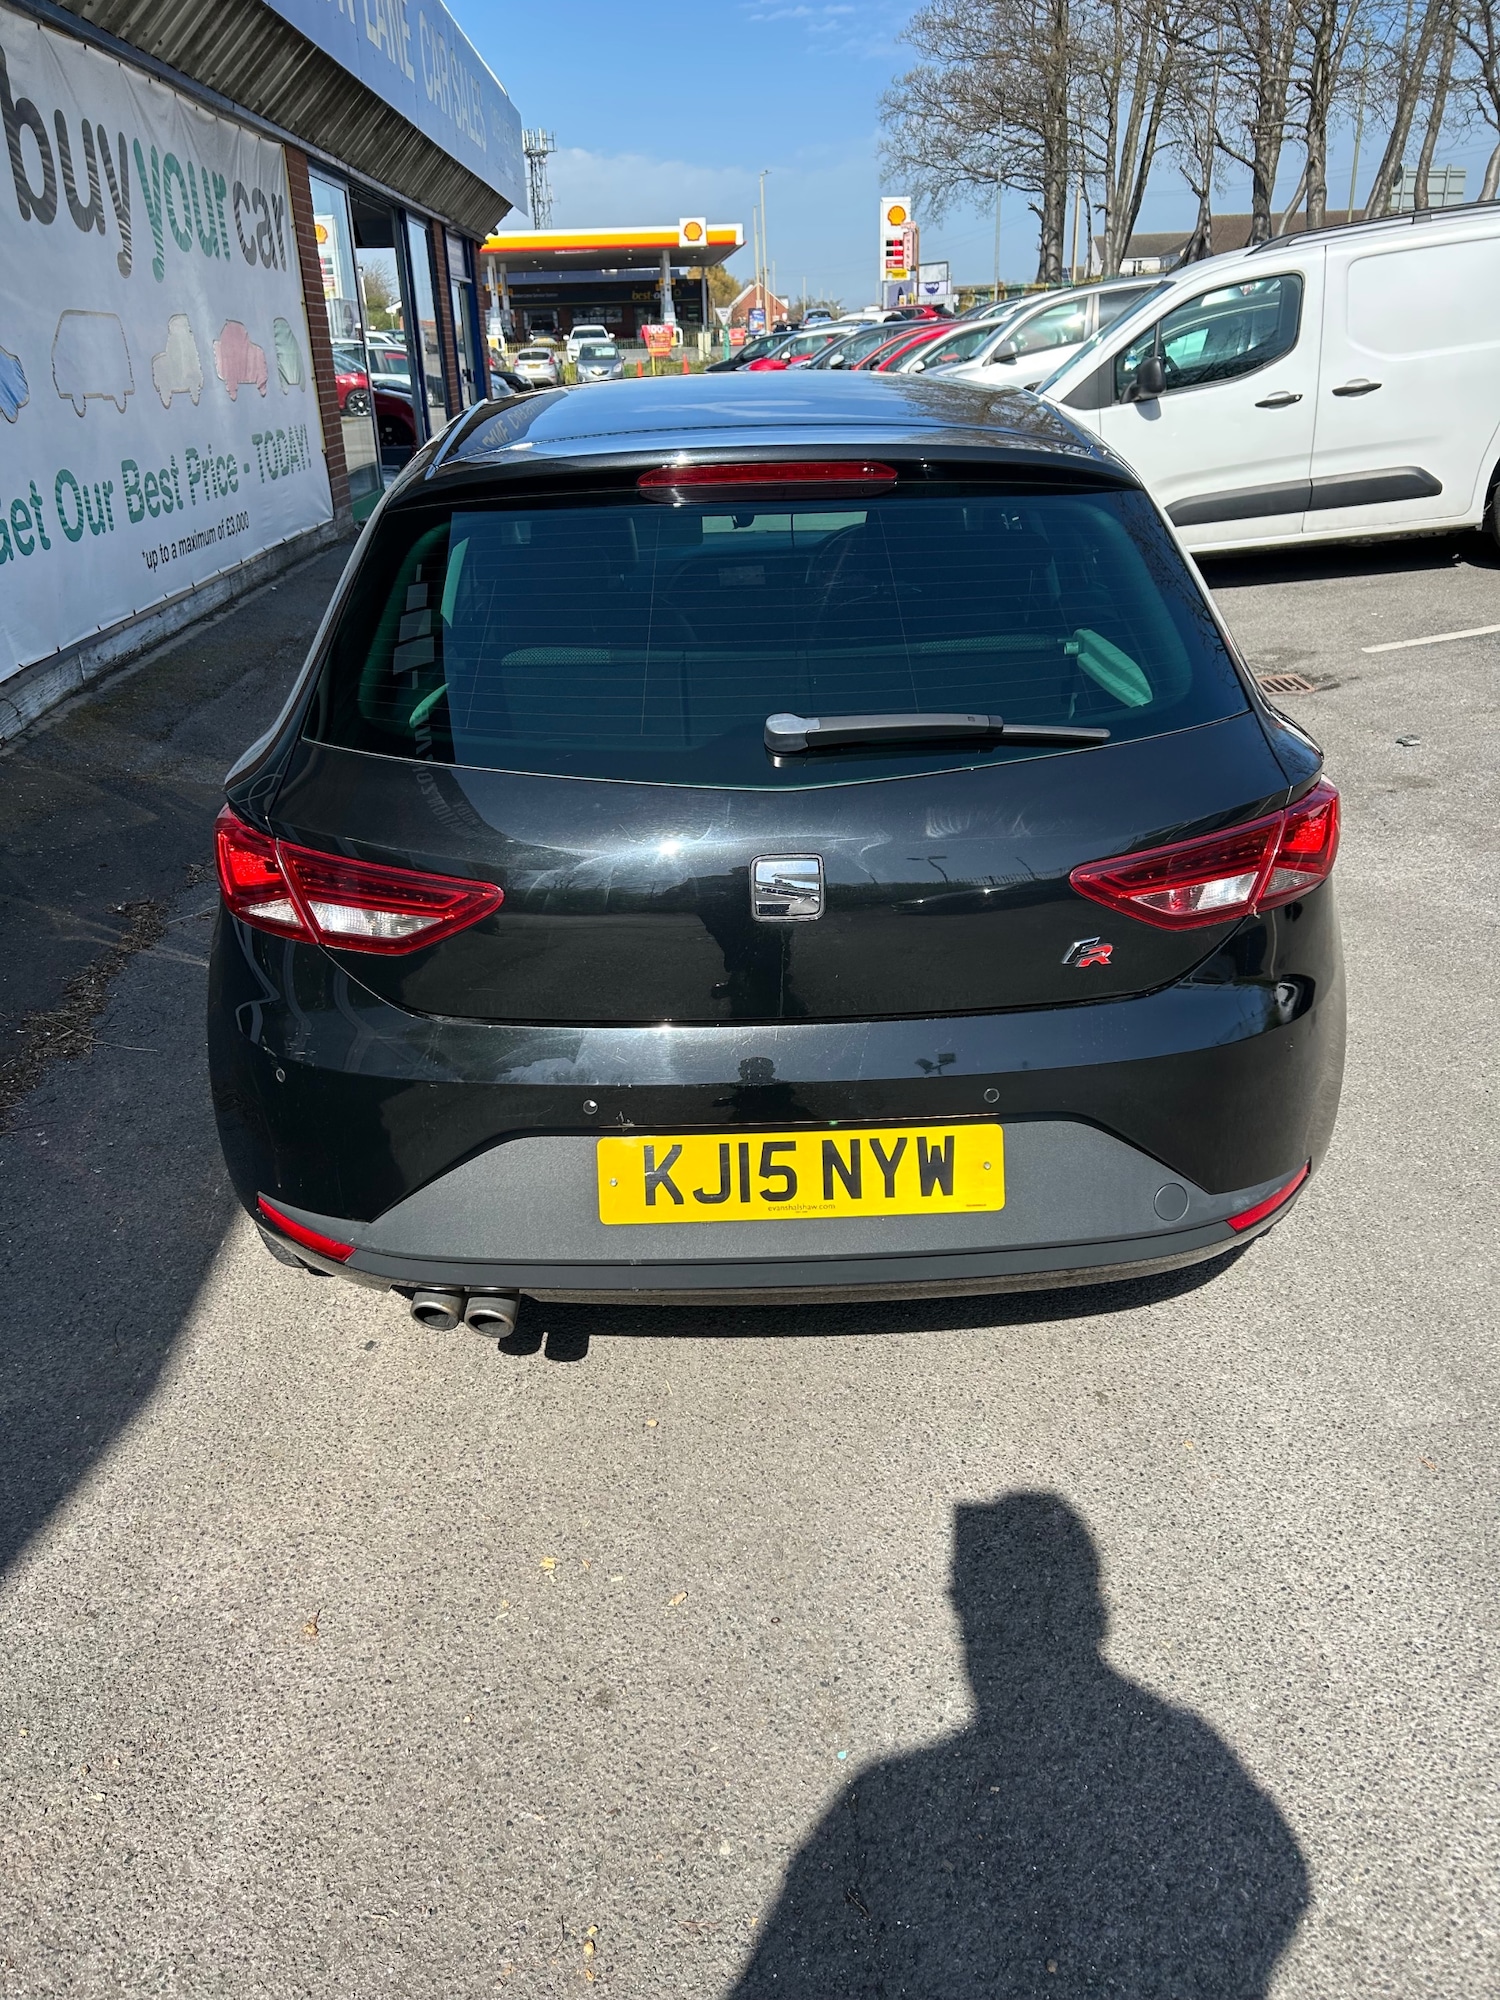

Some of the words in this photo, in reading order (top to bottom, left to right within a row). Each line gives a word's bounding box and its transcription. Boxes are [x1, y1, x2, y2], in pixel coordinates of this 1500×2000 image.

[419, 10, 452, 119] CAR
[451, 52, 486, 153] SALES
[55, 469, 115, 543] Our
[121, 454, 184, 524] Best
[185, 443, 239, 506] Price
[251, 423, 312, 484] TODAY!
[159, 543, 170, 564] to
[171, 542, 178, 559] a
[178, 528, 217, 556] maximum
[217, 519, 226, 540] of
[226, 510, 250, 537] £3,000
[1062, 936, 1113, 968] FR
[643, 1140, 798, 1206] KJ15
[821, 1135, 955, 1201] NYW
[767, 1203, 836, 1212] evanshalshaw.com
